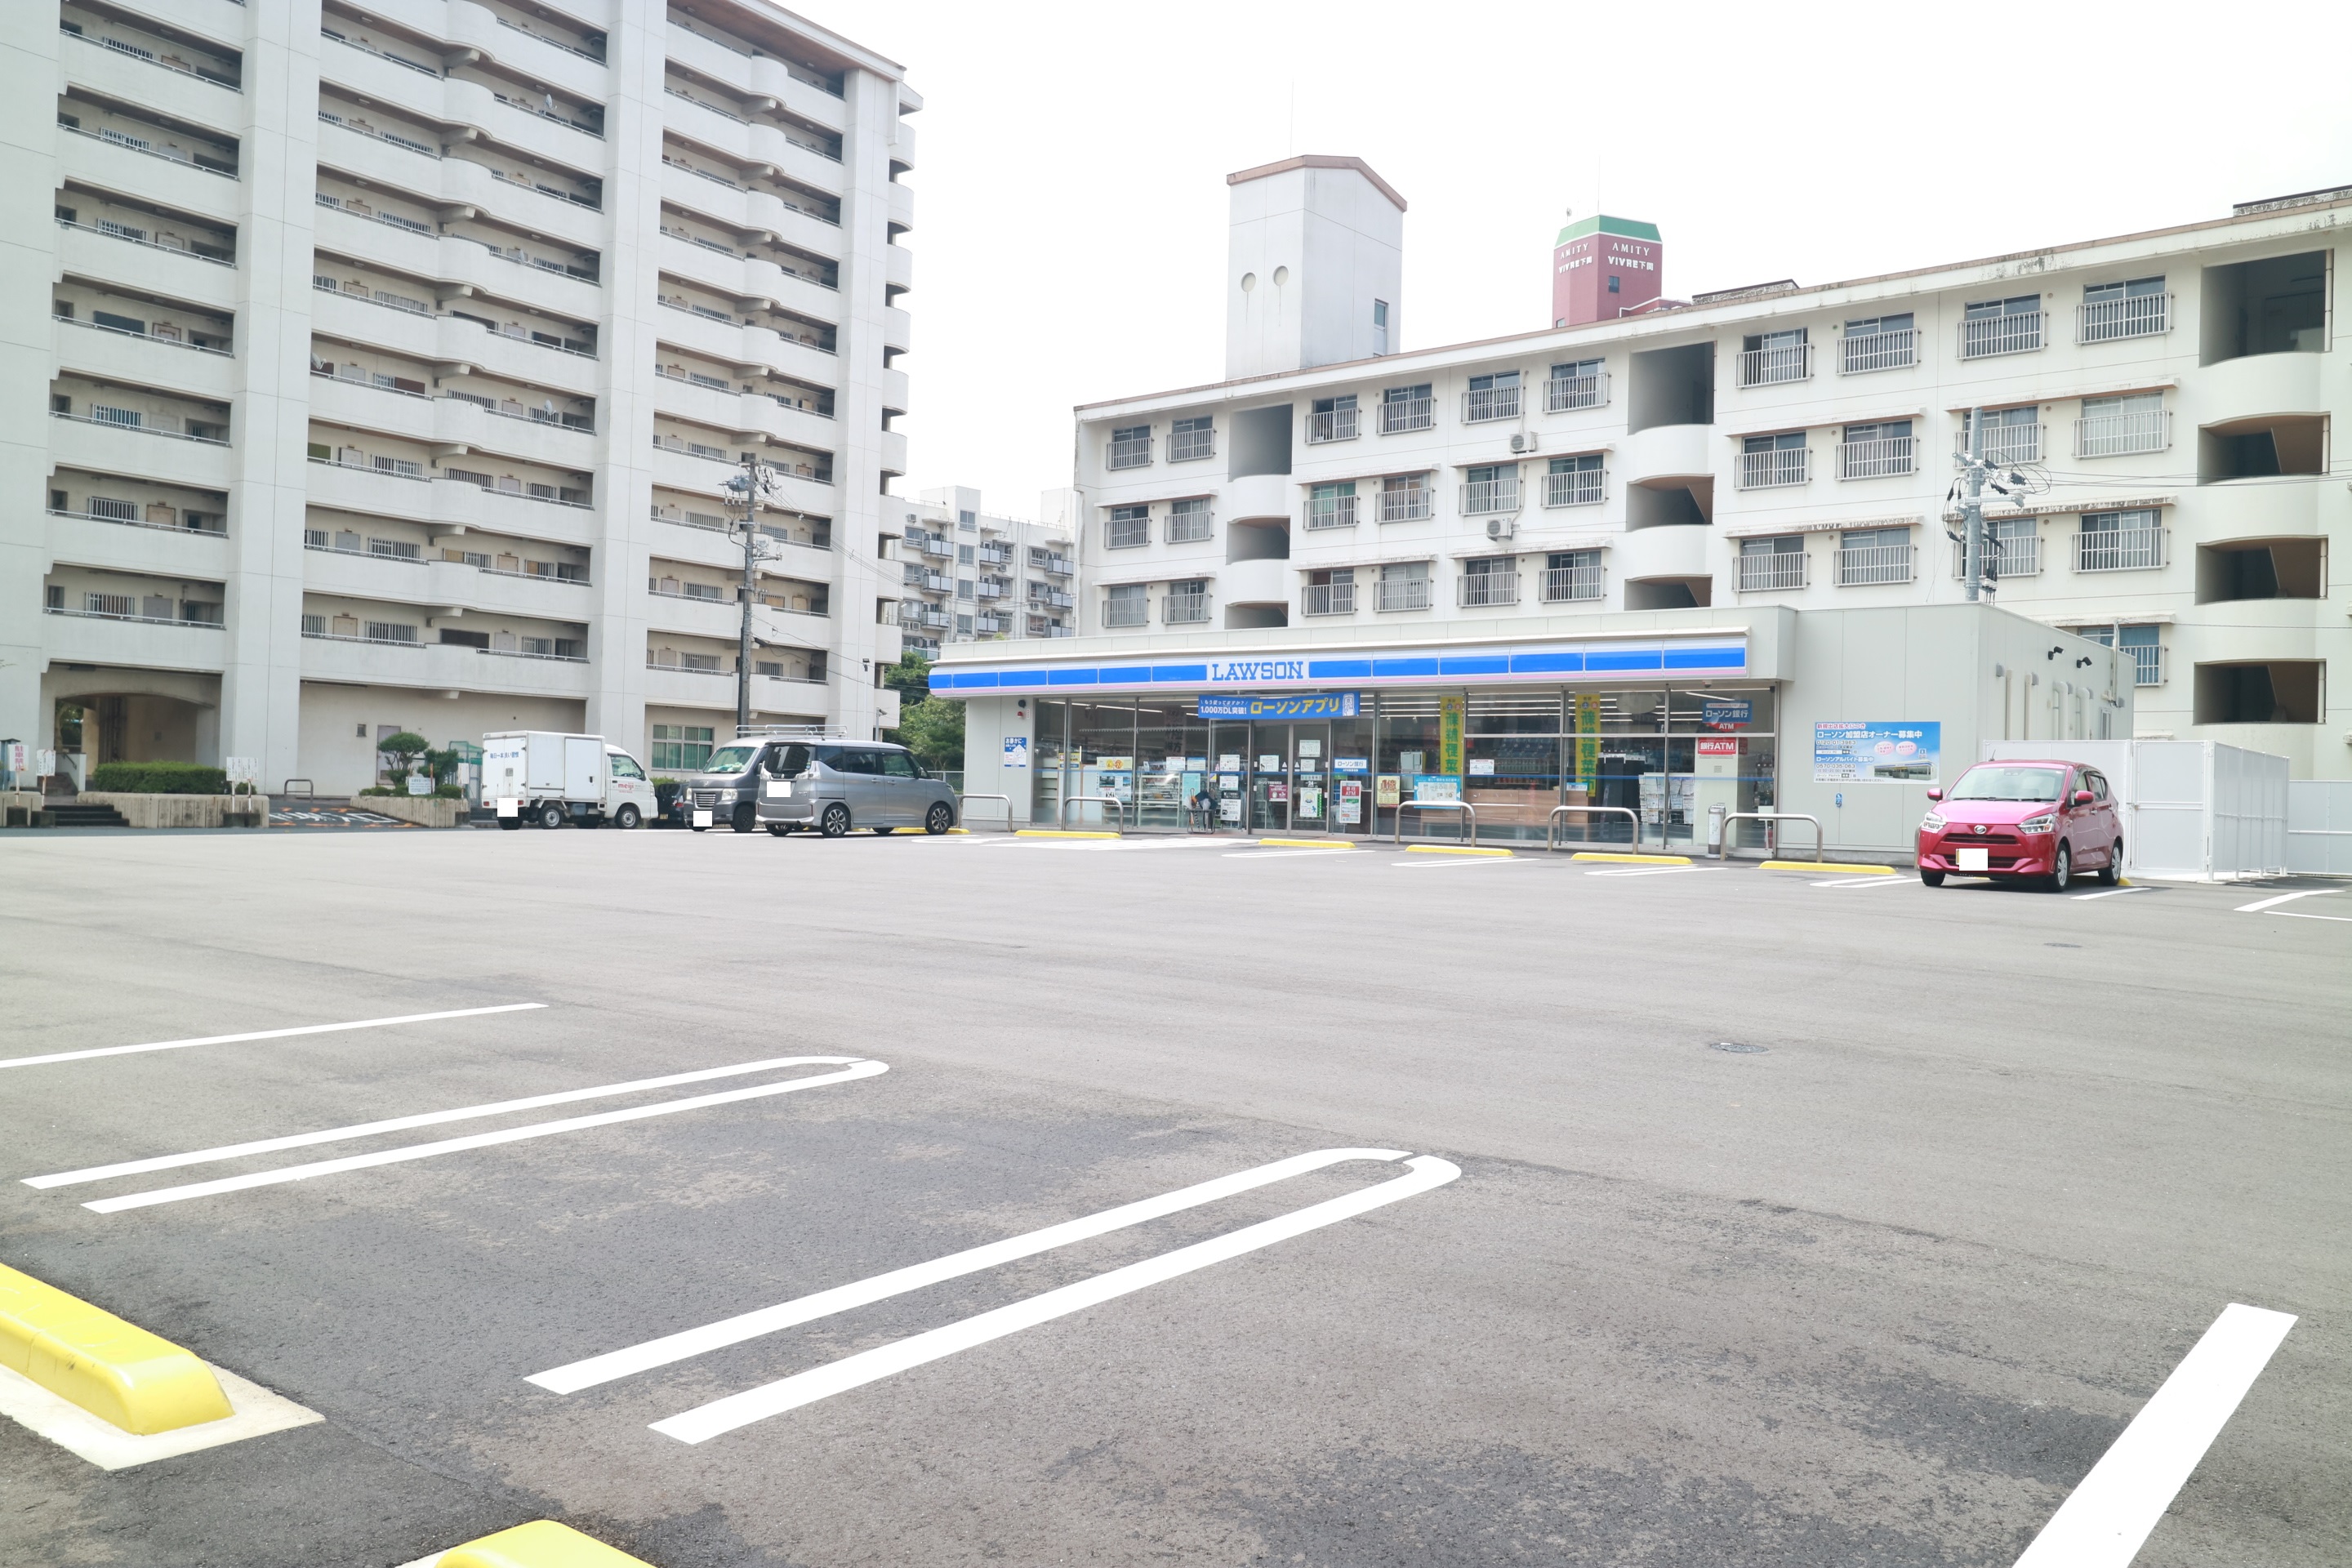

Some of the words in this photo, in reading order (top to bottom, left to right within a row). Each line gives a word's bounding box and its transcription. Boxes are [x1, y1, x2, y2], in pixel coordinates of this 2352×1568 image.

[1560, 243, 1588, 260] AMITY
[1612, 242, 1650, 256] AMITY
[1607, 256, 1654, 271] VIVRE下関
[1212, 662, 1303, 681] LAWSON
[1250, 697, 1339, 715] ローソンアプリ
[1705, 710, 1748, 718] ローソン銀行
[1817, 731, 1922, 739] ローソン加盟店オーナー募集中
